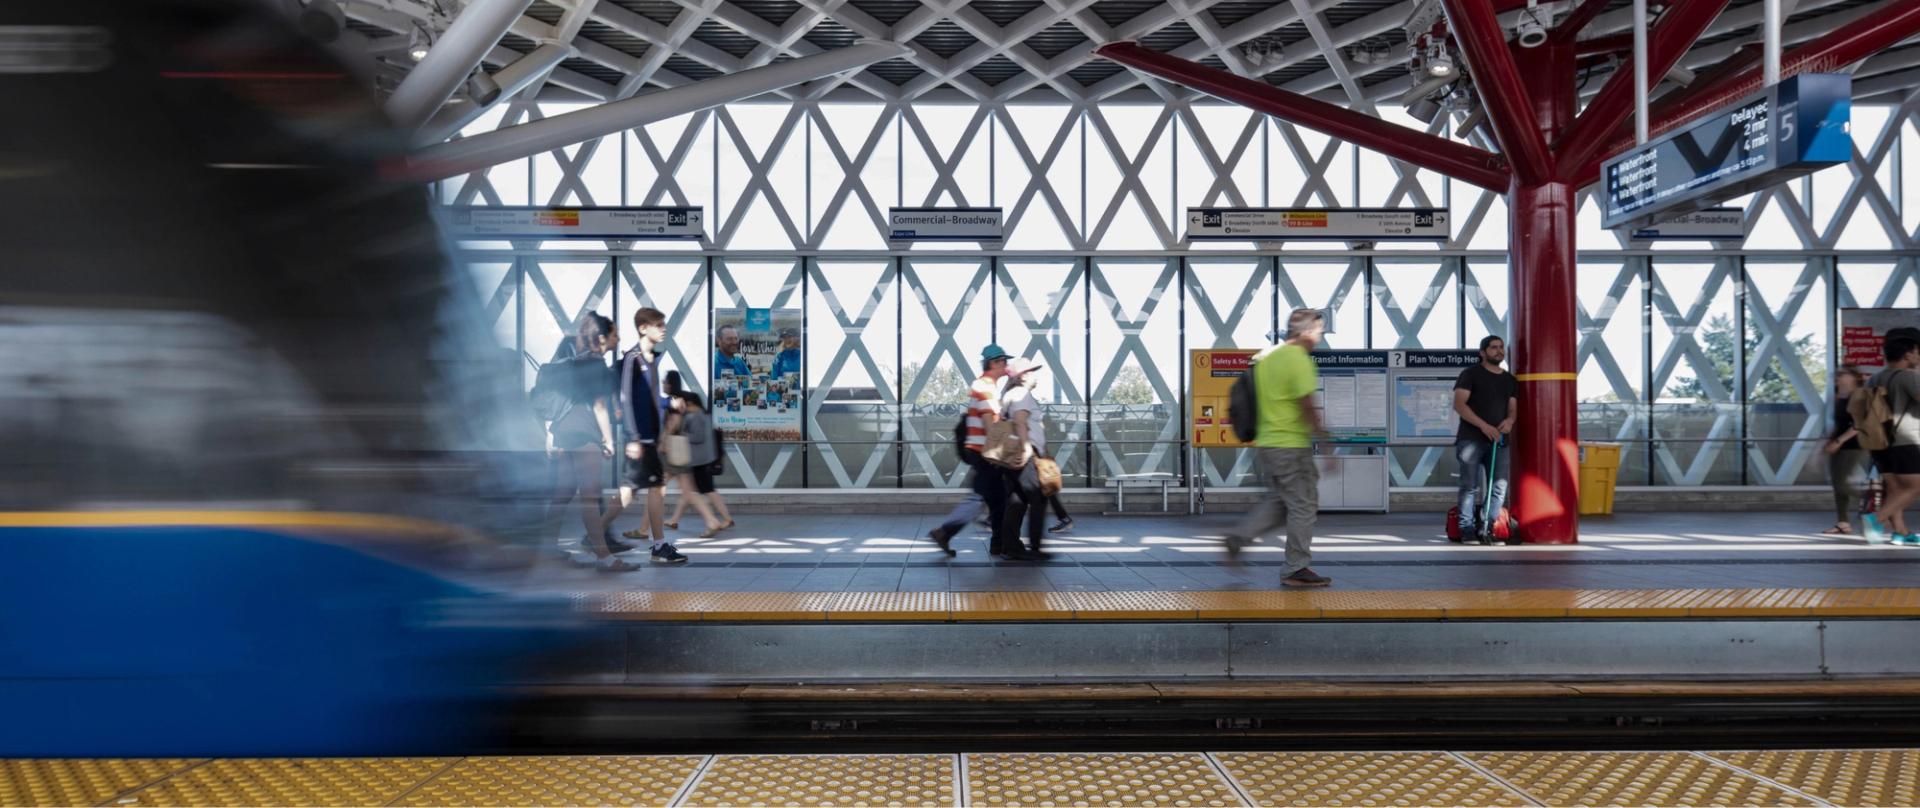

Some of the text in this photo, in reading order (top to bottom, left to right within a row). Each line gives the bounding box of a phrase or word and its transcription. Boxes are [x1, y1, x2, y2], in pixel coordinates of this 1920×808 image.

[1744, 123, 1751, 136] 2
[1781, 112, 1794, 142] 5
[1744, 140, 1751, 151] 4
[1619, 148, 1658, 173] Waterfront
[1619, 161, 1658, 187] Waterfront
[1619, 176, 1658, 201] Waterfront
[669, 214, 686, 223] Exit
[1203, 214, 1220, 224] Exit
[1415, 214, 1432, 224] Exit
[1848, 346, 1877, 354] protect
[1213, 358, 1231, 366] Safety
[1311, 355, 1384, 364] Transit Information
[1394, 352, 1402, 366] ?
[1409, 355, 1480, 366] Plan Your Trip Her
